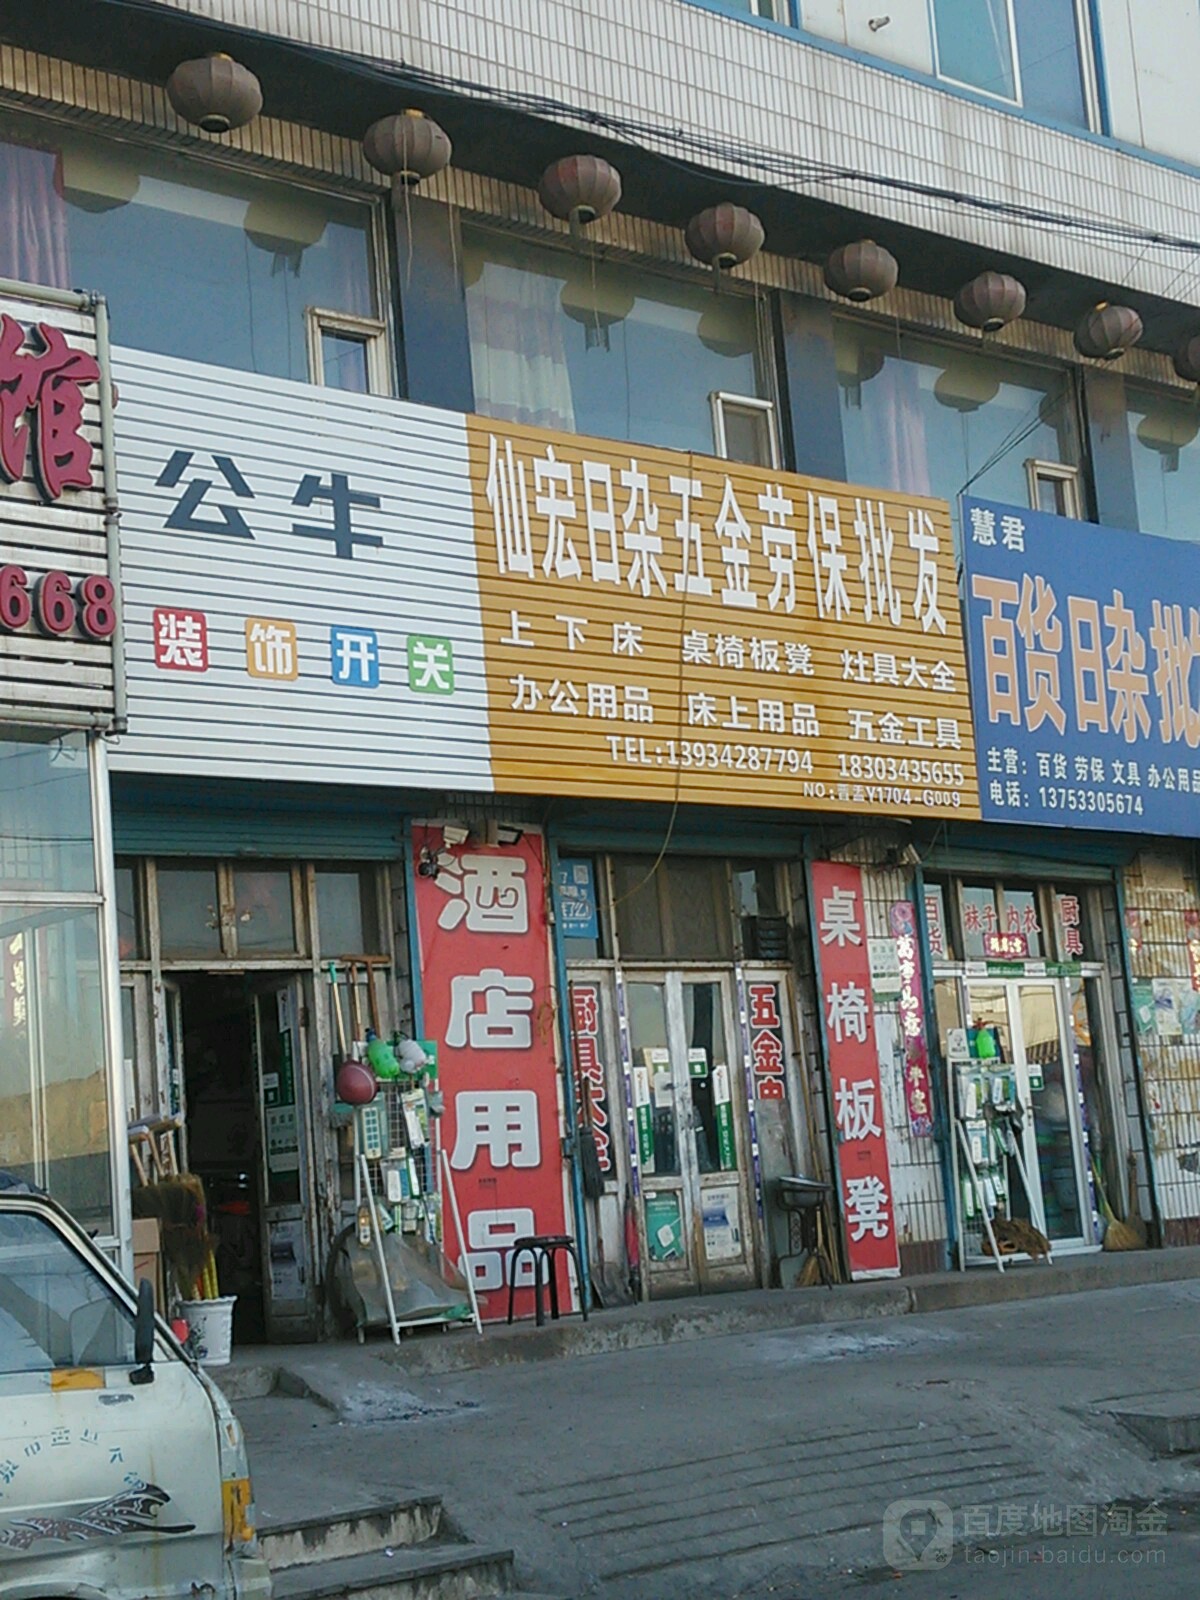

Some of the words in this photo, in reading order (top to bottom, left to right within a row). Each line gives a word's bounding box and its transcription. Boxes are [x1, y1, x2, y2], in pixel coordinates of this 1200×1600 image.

[155, 450, 384, 560] 公牛
[486, 433, 947, 635] 仙宏日杂五金劳保批发
[970, 507, 1026, 553] 慧君
[157, 612, 451, 690] 装饰开关
[682, 628, 815, 676] 桌椅板凳
[840, 649, 957, 692] 灶具大全
[509, 674, 654, 724] 办公用品
[687, 692, 821, 737] 床上用品
[847, 708, 963, 751] 五金工具
[837, 752, 964, 786] 18303435655
[1037, 752, 1067, 780] 百货
[1074, 756, 1105, 783] 劳保
[1111, 759, 1142, 787] 文具
[1060, 896, 1083, 954] 厨具
[435, 853, 552, 1292] 酒店用品
[820, 887, 889, 1241] 桌椅板凳
